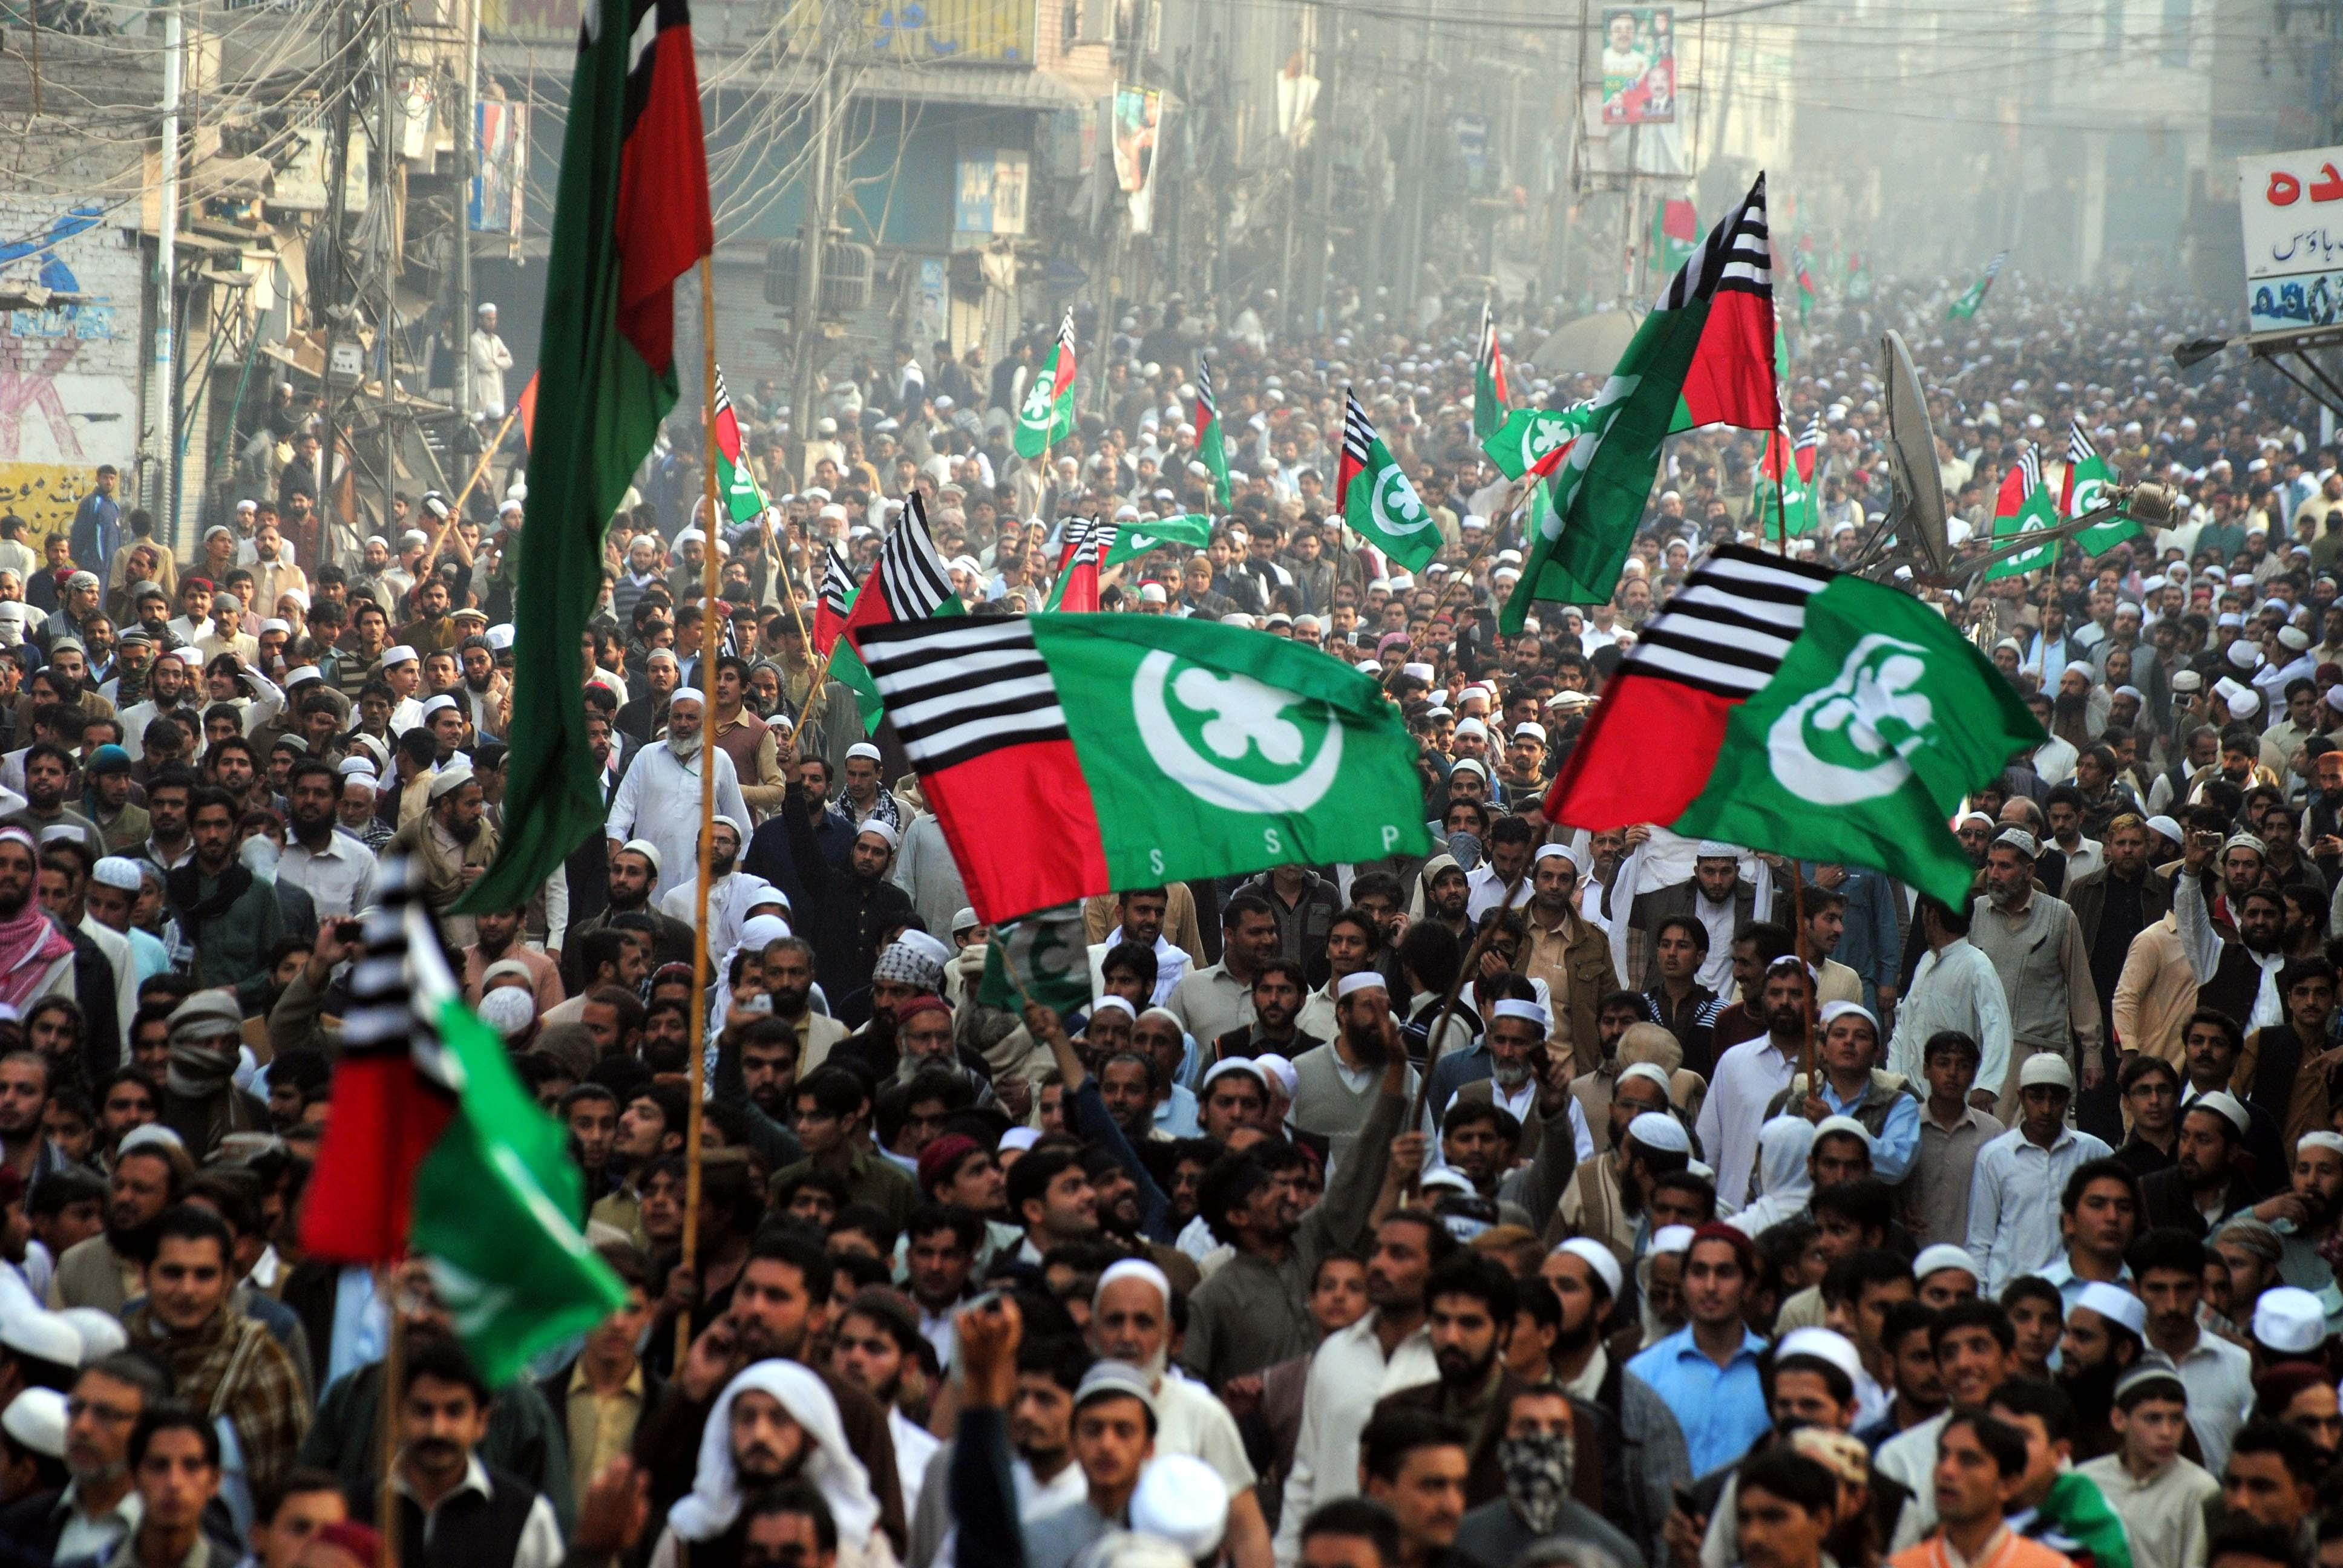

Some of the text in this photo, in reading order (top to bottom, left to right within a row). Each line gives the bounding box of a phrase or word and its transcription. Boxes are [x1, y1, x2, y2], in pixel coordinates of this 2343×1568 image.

[1150, 825, 1399, 875] S S P
